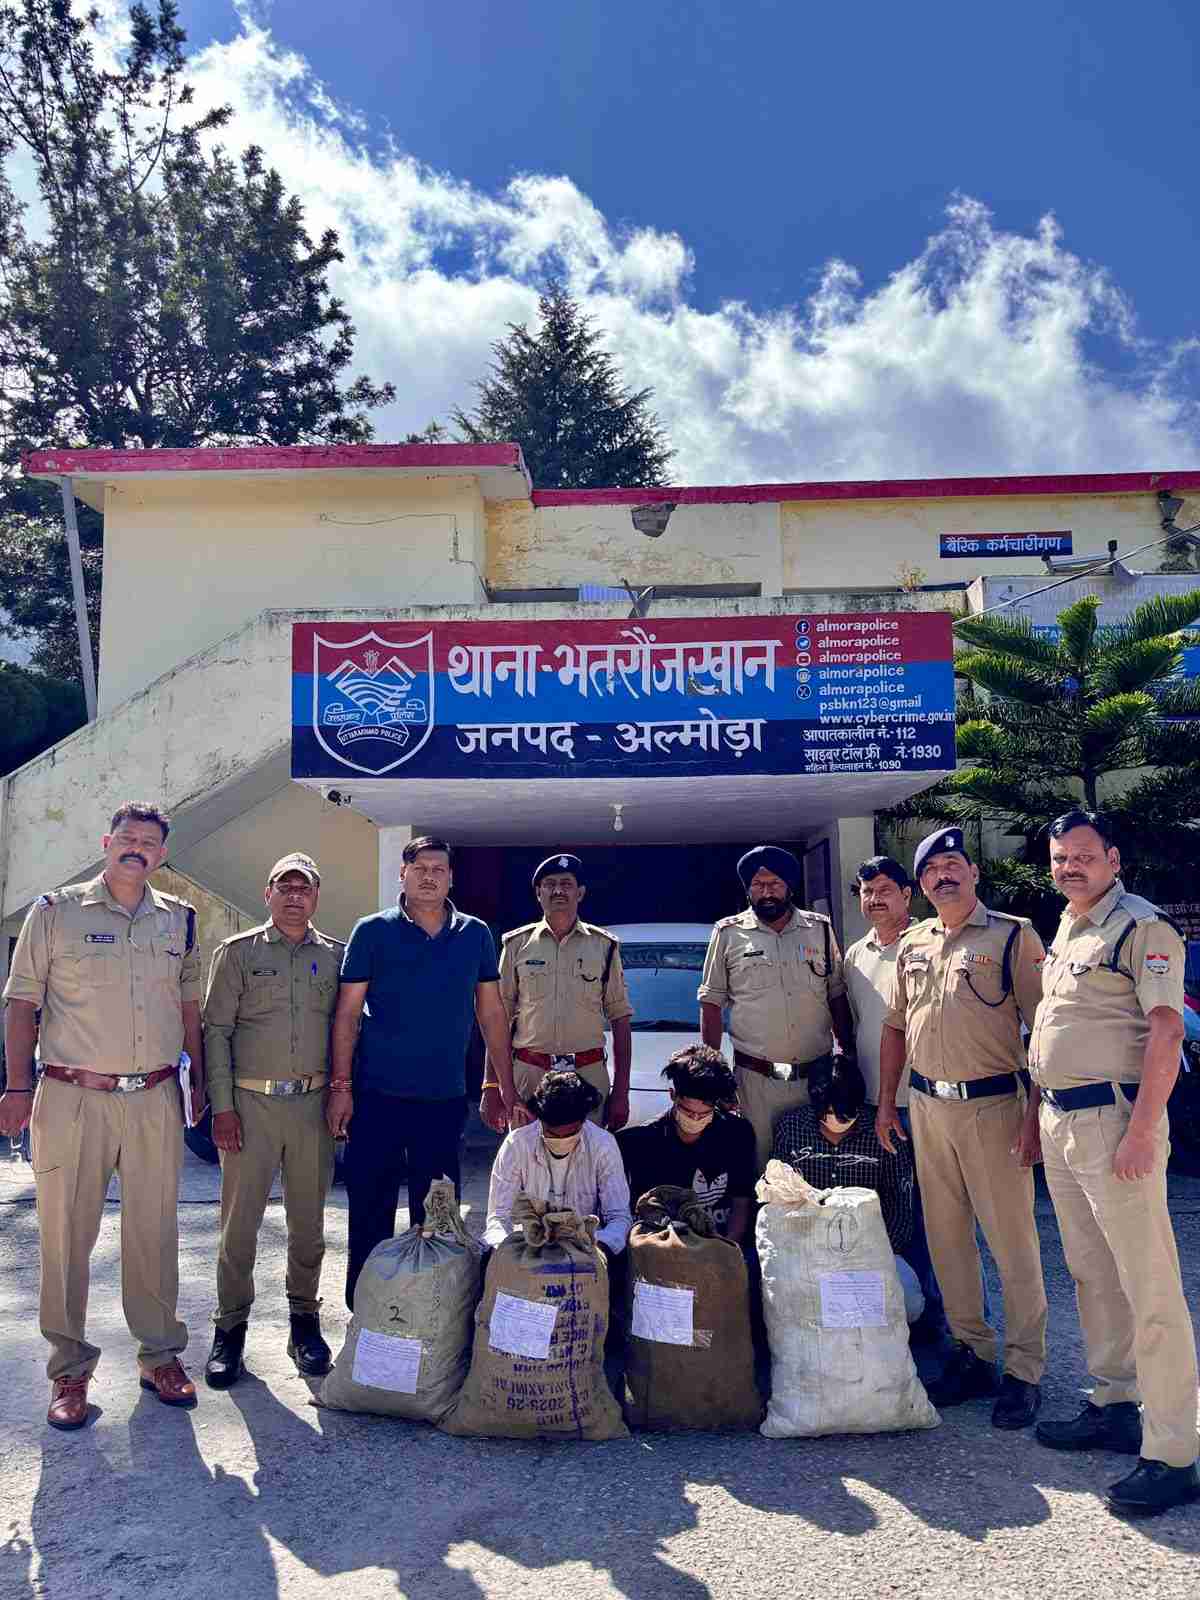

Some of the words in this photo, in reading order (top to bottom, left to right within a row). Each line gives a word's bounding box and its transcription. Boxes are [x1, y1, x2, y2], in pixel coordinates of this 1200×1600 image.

[986, 534, 1063, 552] कर्मचारीगण
[816, 618, 899, 634] almorapolice
[817, 634, 900, 649] almorapolice
[819, 650, 902, 664] almorapolice
[819, 665, 904, 681] almorapolice
[819, 681, 905, 697] almorapolice
[819, 694, 922, 714] psbkn123@gmail
[455, 721, 580, 759] जनपद
[614, 707, 768, 758] अल्मोड़ा
[803, 725, 876, 742] आपातकालीन
[389, 1306, 408, 1324] 2
